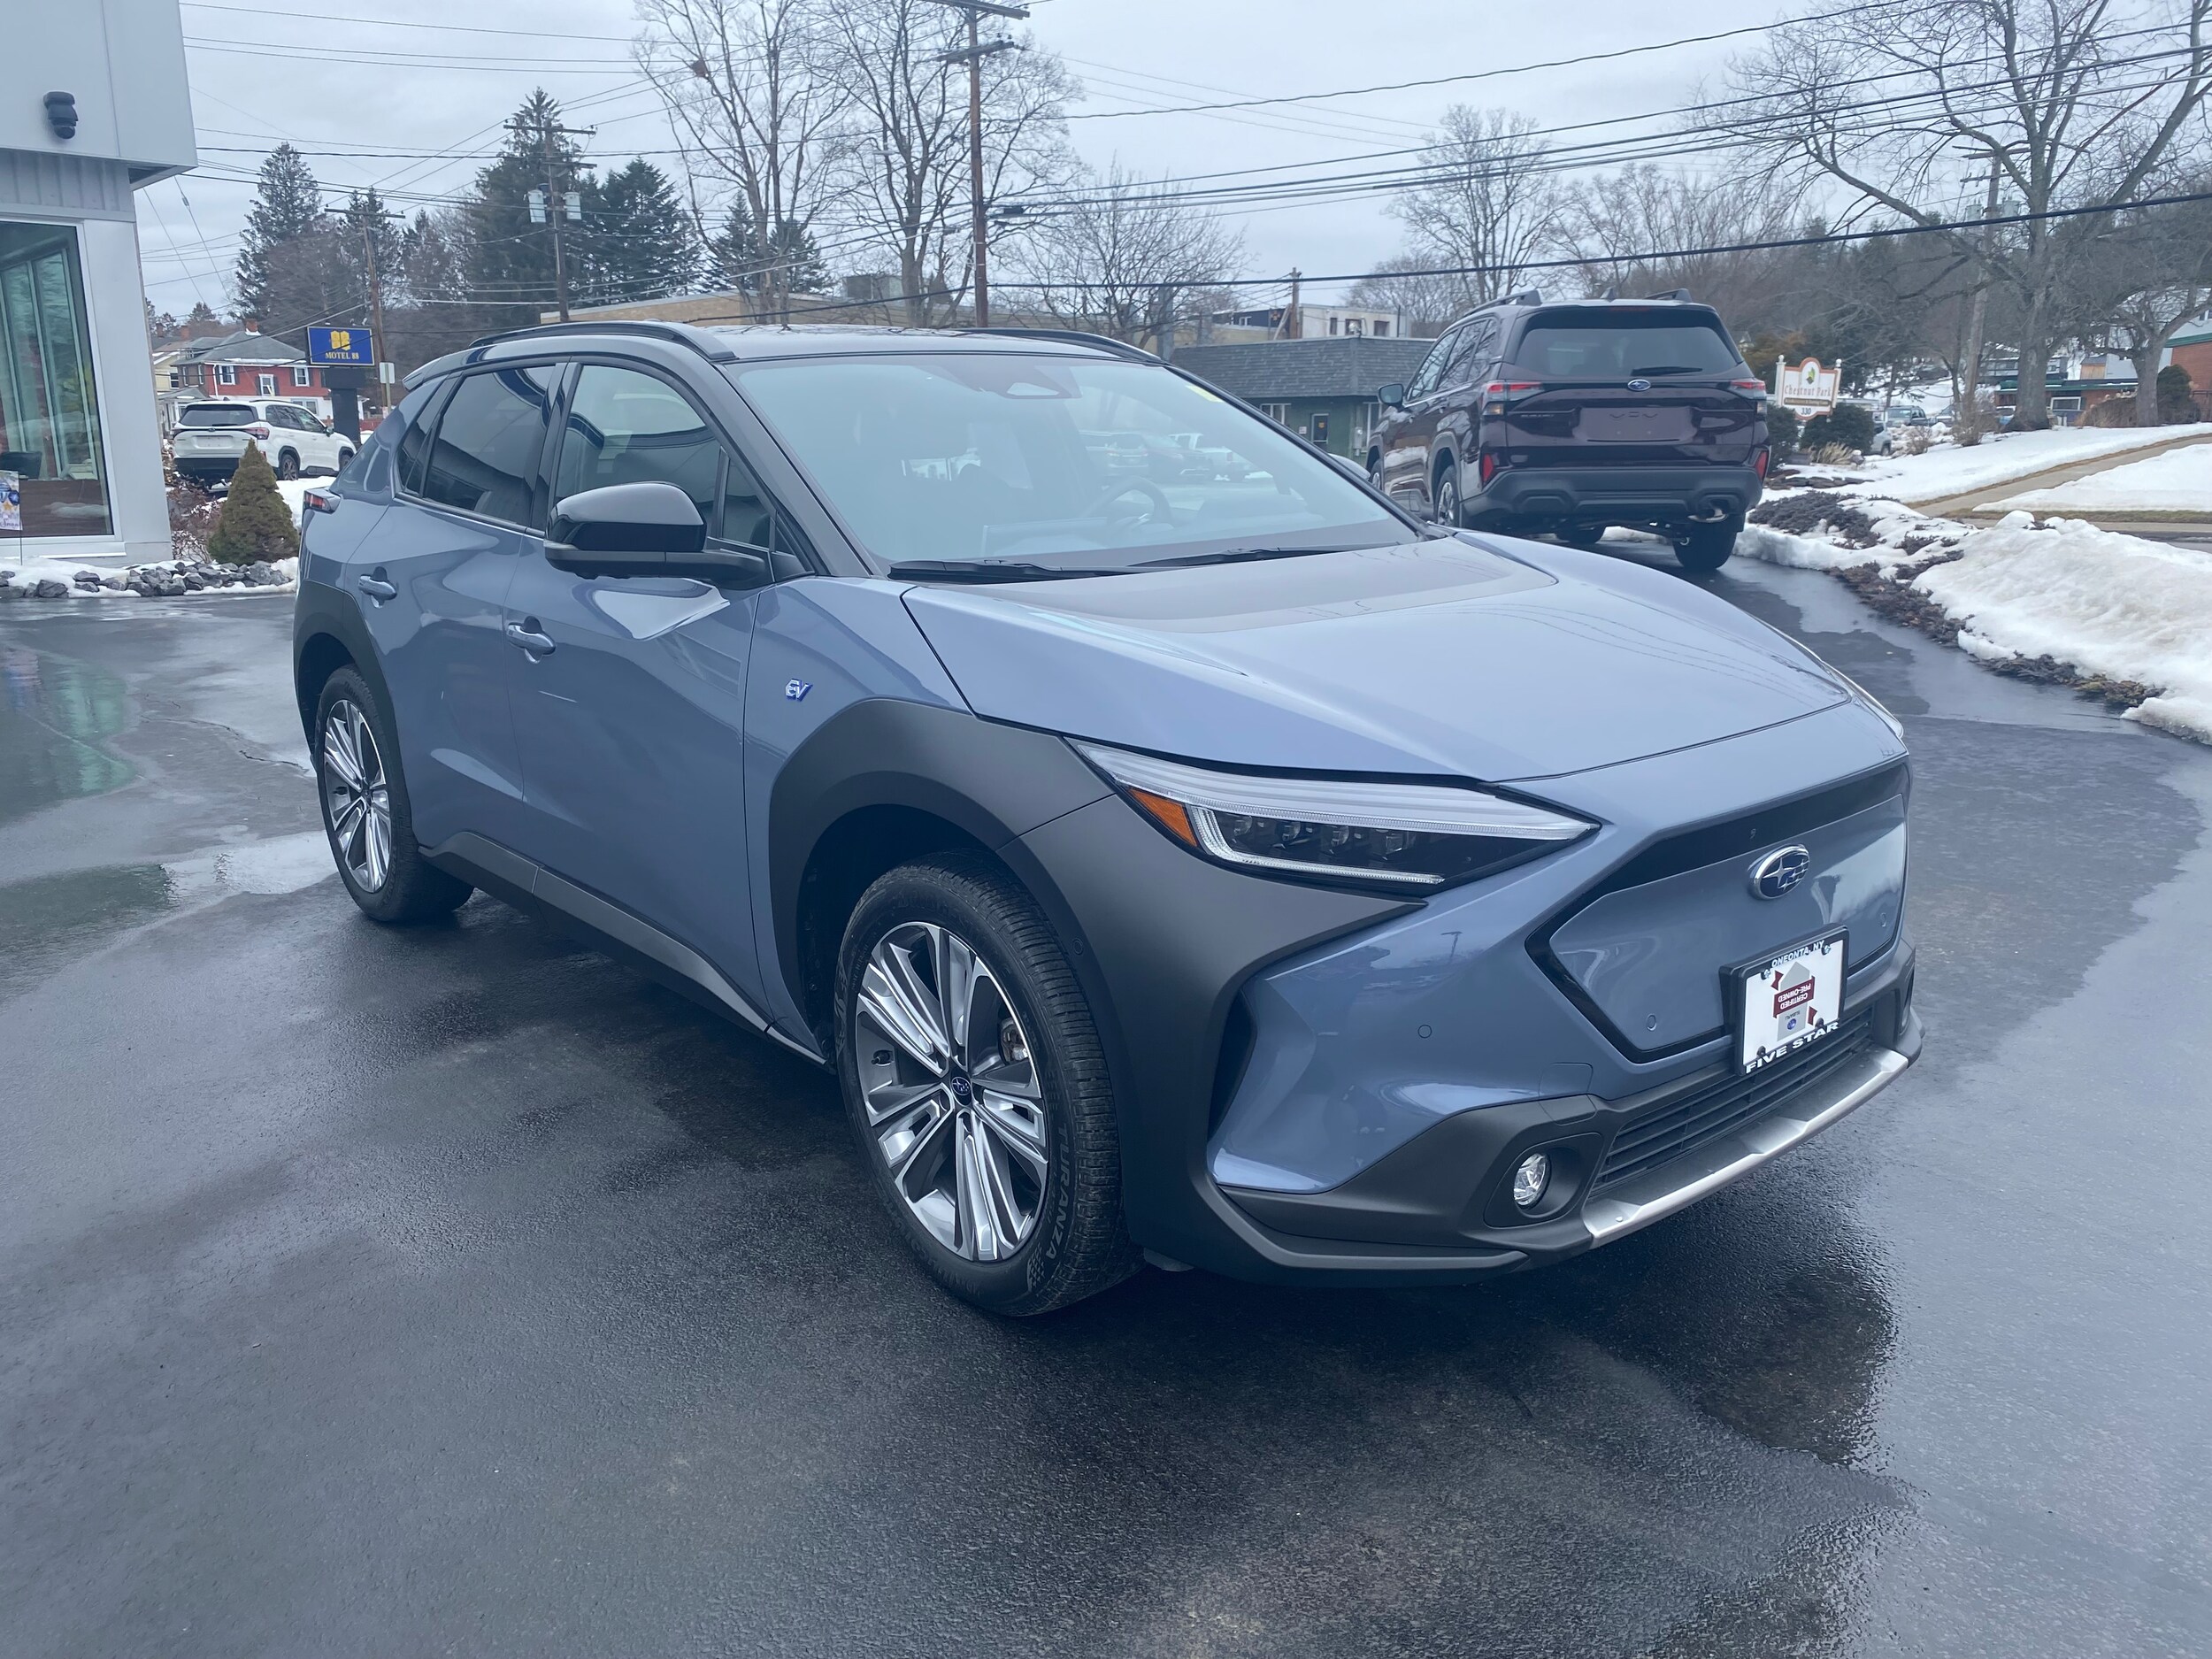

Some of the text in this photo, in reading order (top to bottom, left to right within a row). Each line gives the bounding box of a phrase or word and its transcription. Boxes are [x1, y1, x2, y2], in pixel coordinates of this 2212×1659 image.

[325, 351, 351, 360] MOTEL
[1784, 385, 1831, 397] Chestnut Park
[785, 678, 813, 702] EV
[1771, 940, 1824, 968] ONEONTA, NY
[1778, 983, 1811, 1002] PRE-OWNED
[1780, 993, 1809, 1010] CERTIFIED
[1746, 1021, 1839, 1074] FIVE STAR
[1046, 1123, 1070, 1259] TURANZA
